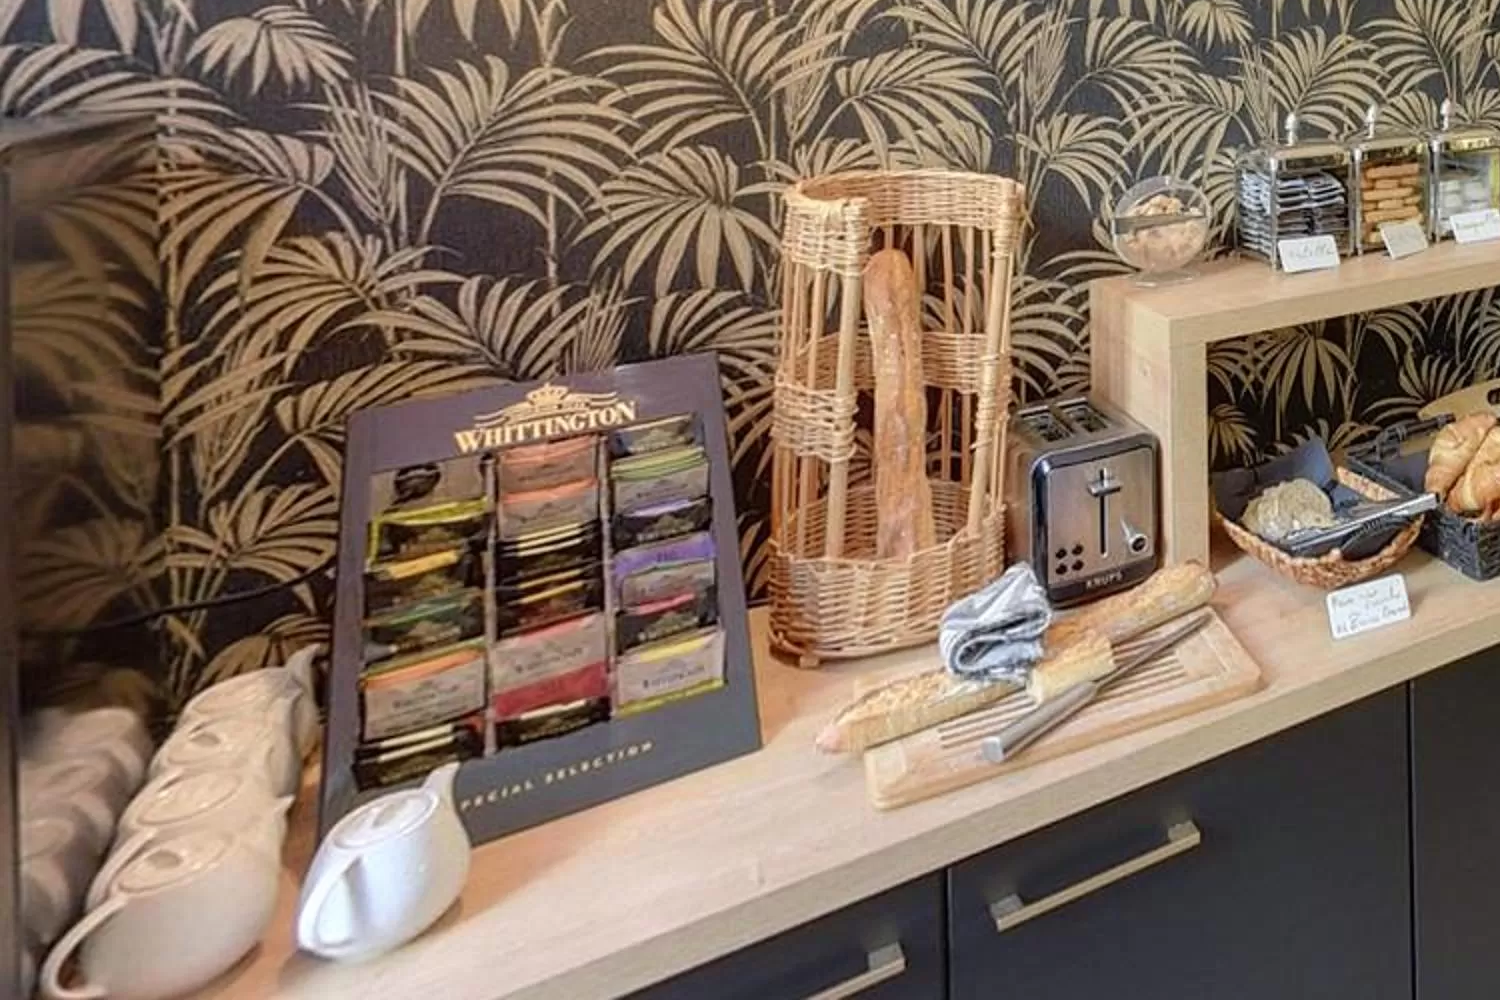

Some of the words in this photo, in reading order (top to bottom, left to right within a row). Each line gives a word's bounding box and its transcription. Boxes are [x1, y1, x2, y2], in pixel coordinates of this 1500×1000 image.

[454, 400, 638, 454] WHITTINGTON
[1085, 571, 1124, 589] KRUPS
[459, 779, 534, 812] PECIAL
[545, 741, 653, 786] SELECTION
